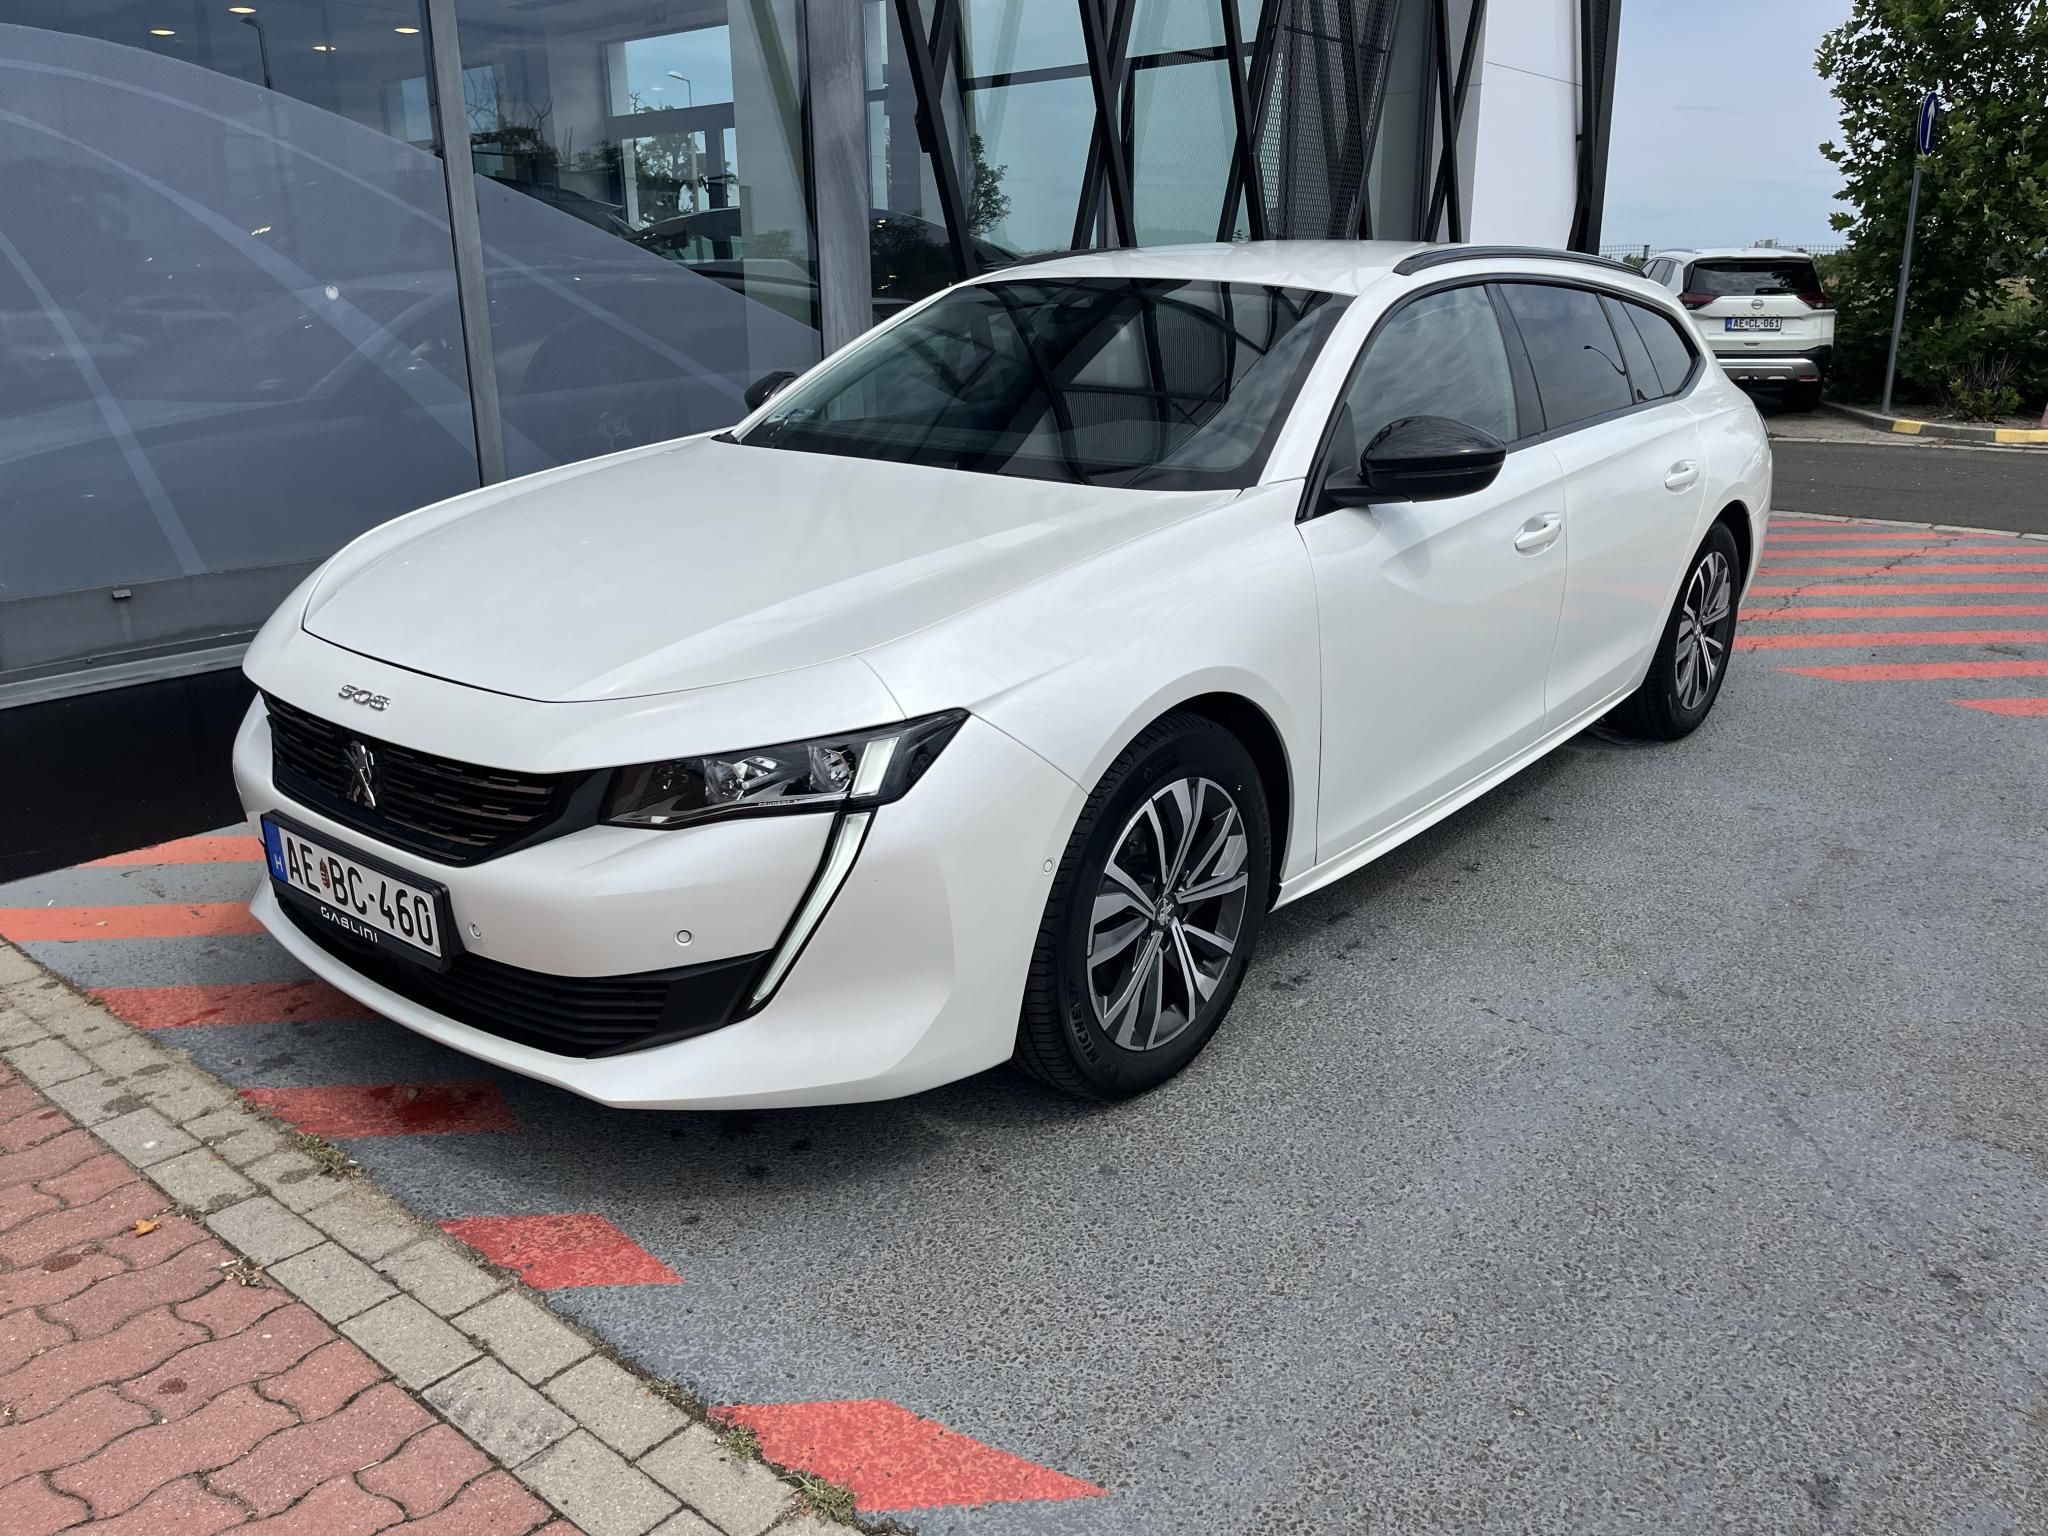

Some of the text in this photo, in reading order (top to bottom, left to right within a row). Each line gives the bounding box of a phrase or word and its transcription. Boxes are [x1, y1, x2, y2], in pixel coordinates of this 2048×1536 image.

[1733, 318, 1745, 328] AE
[1749, 318, 1779, 328] CL-061
[338, 684, 391, 711] 508
[274, 855, 284, 873] H
[286, 836, 433, 946] AE BC-460
[320, 906, 378, 943] GABLINI
[1069, 978, 1101, 1063] MICHEL
